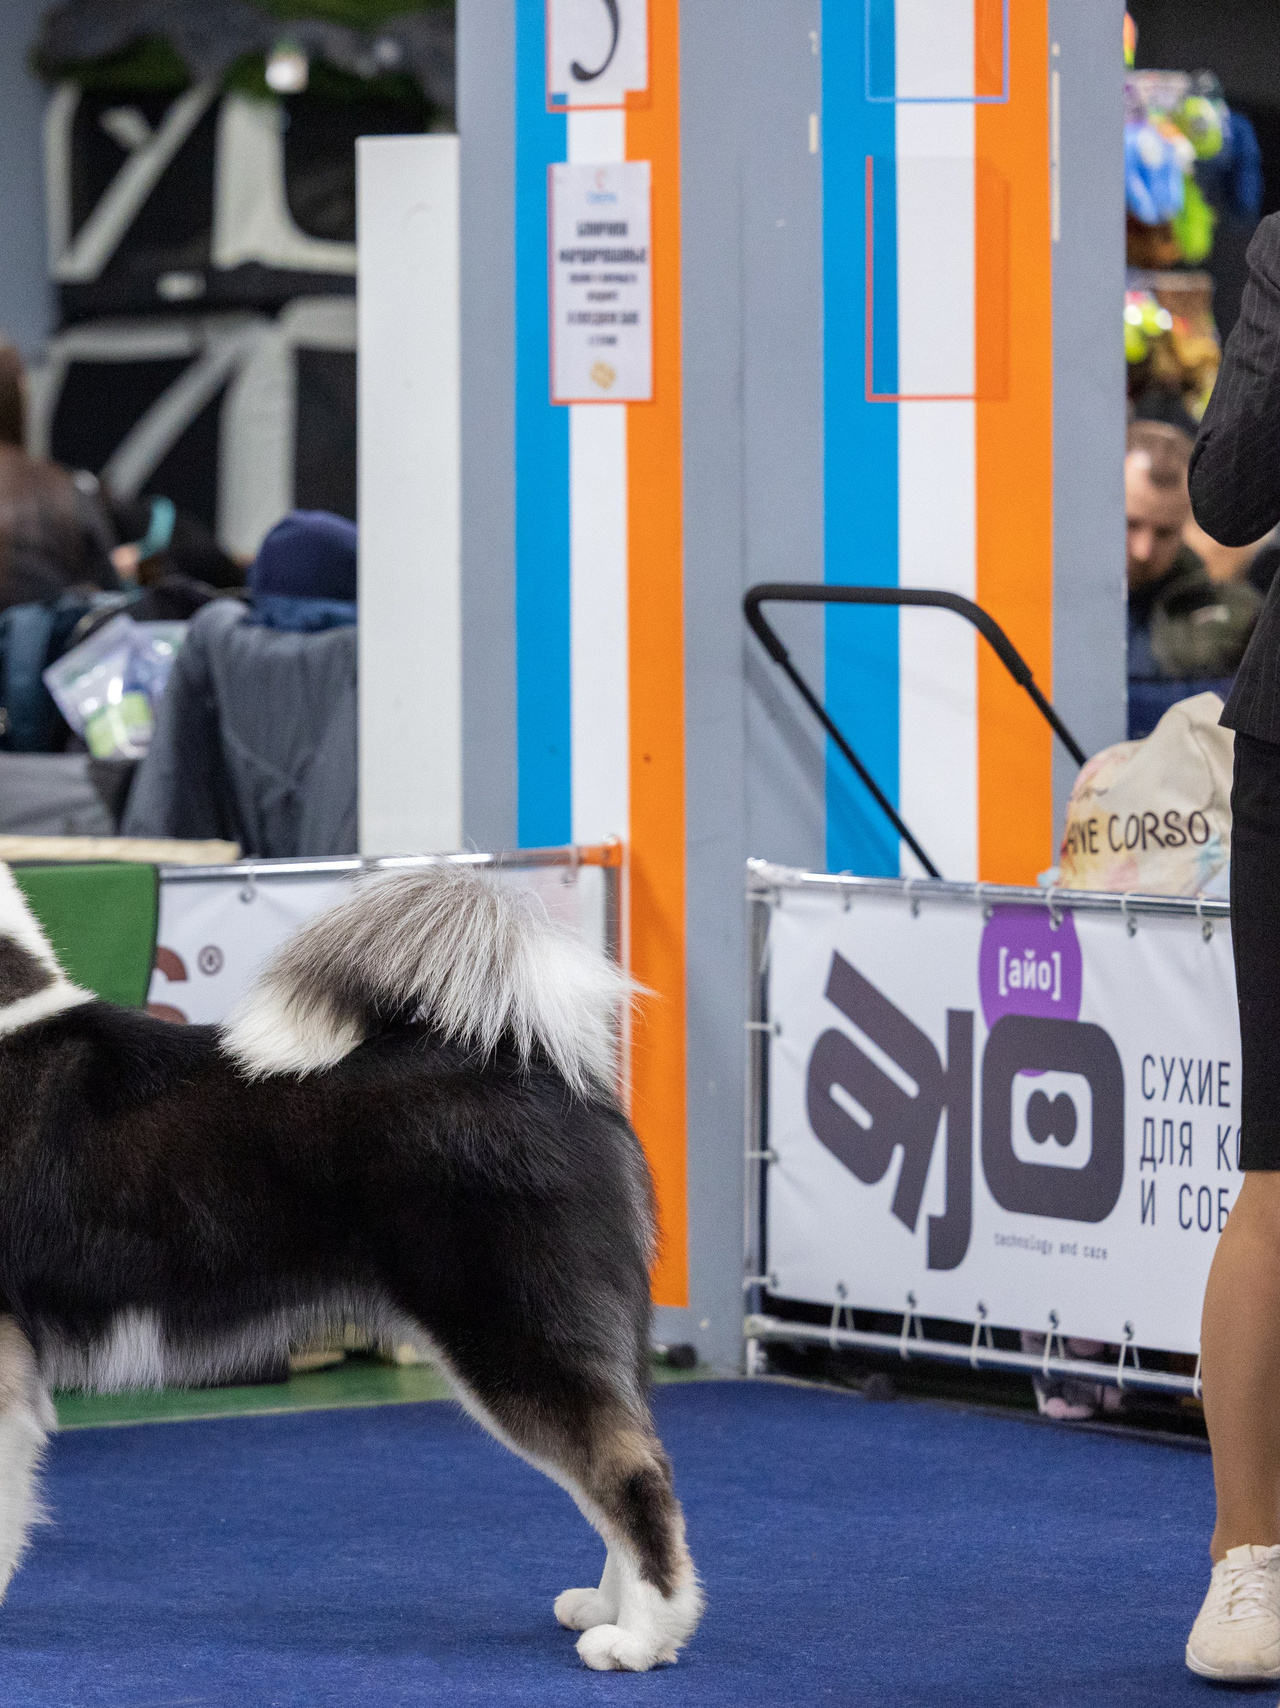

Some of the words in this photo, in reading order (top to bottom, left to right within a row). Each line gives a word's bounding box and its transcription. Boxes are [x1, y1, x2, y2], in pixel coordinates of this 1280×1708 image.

[1108, 811, 1210, 852] CORSO
[1142, 1054, 1231, 1107] СУХИЕ
[1140, 1117, 1193, 1173] ДЛЯ
[1141, 1179, 1156, 1226] И
